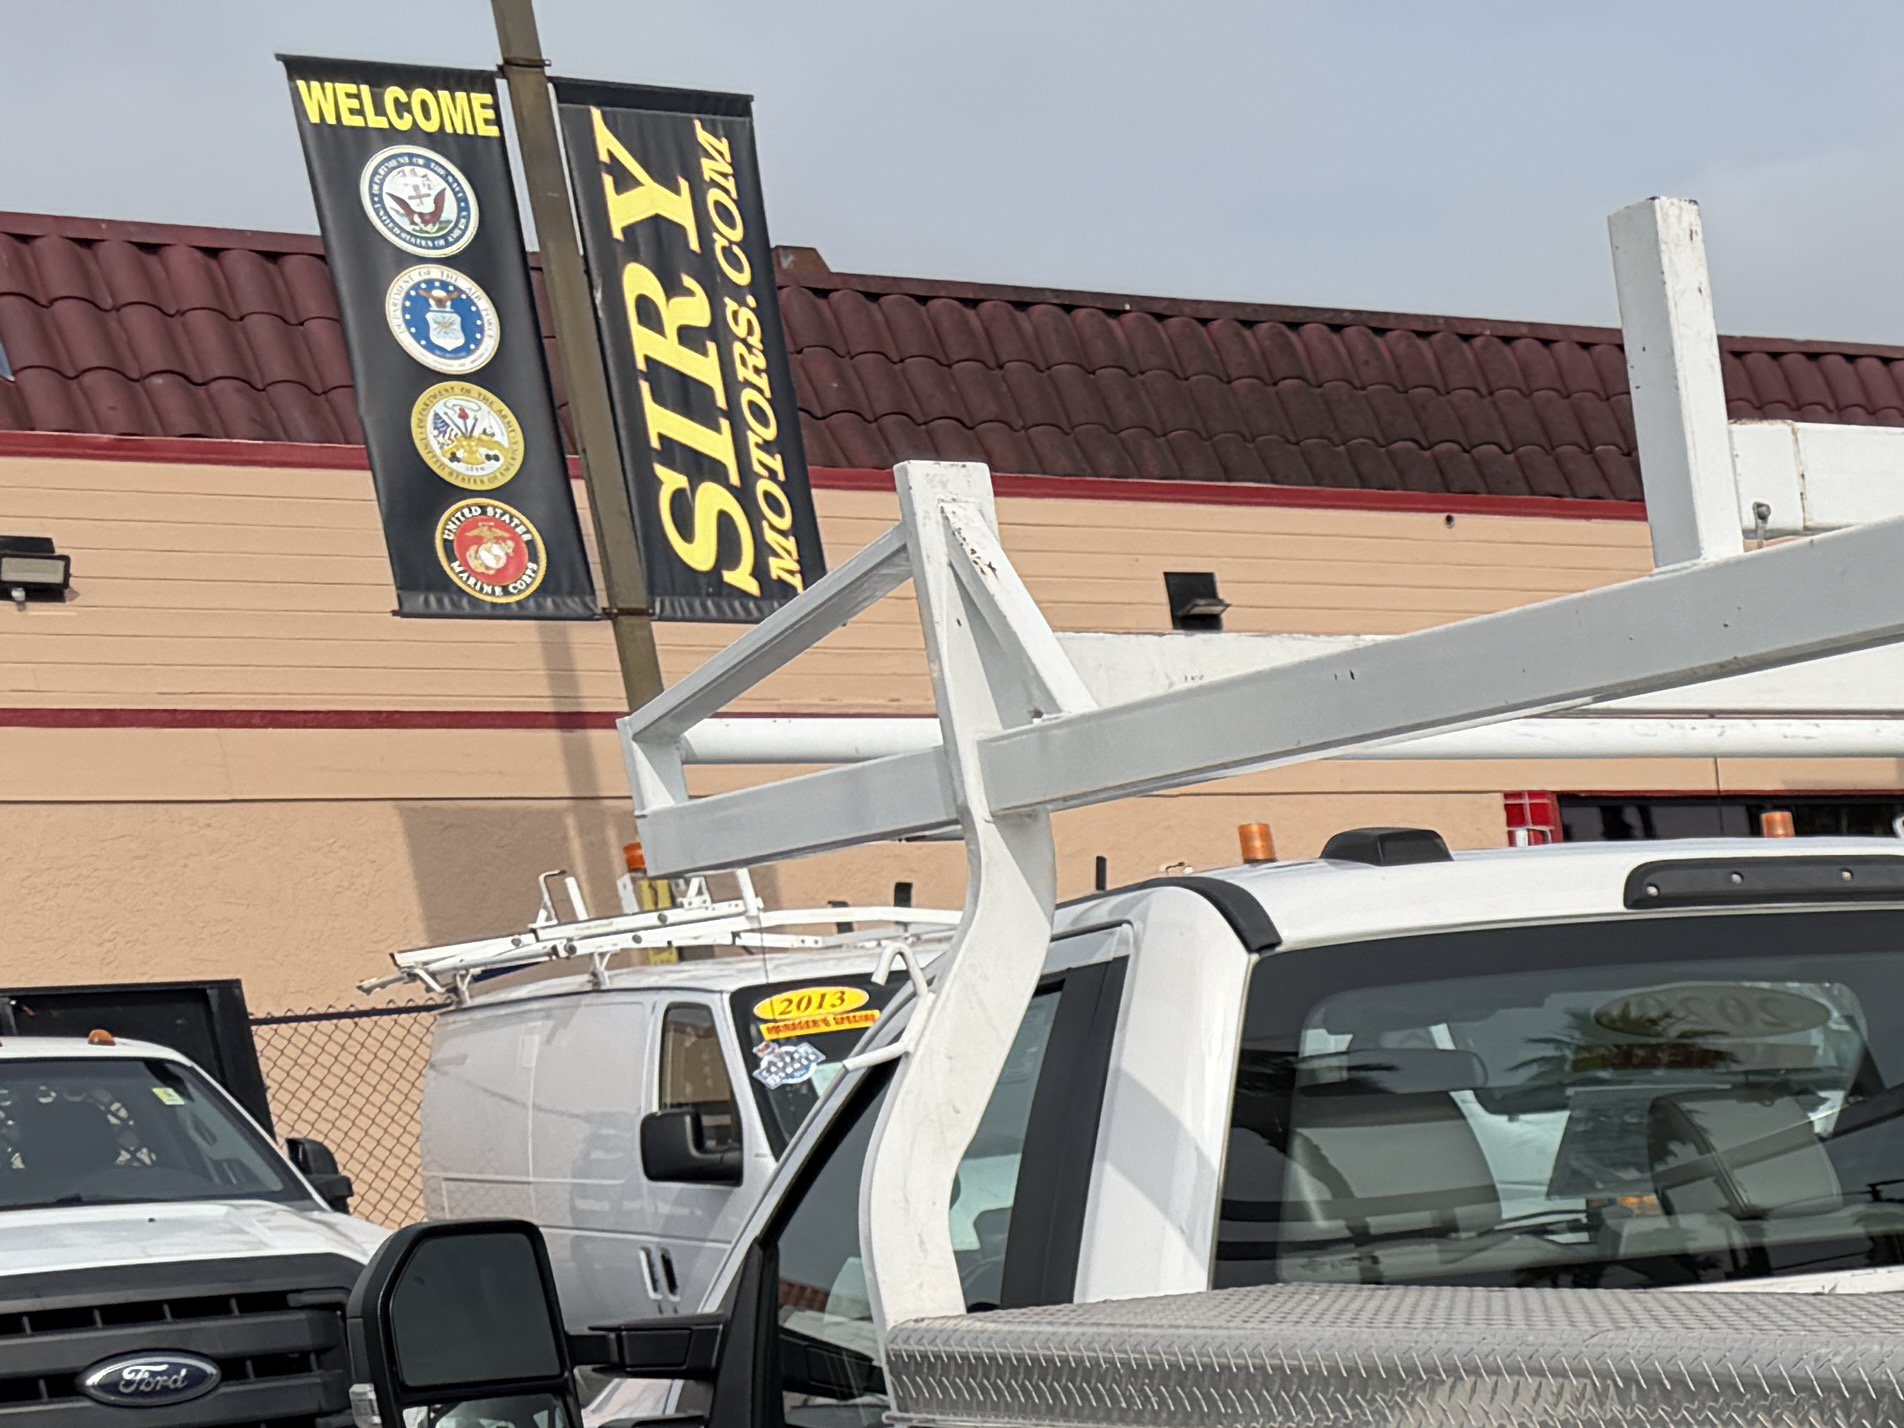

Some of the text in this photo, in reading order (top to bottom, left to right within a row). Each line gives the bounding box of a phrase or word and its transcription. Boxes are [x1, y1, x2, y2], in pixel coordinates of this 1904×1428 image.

[295, 79, 501, 138] WELCOME
[590, 105, 762, 598] SIRY
[694, 118, 806, 594] MOTORS.COM
[443, 506, 533, 542] UNITED STATES
[450, 560, 538, 597] MARINE CORPS
[778, 990, 846, 1016] 2013
[118, 1364, 188, 1394] Ford
